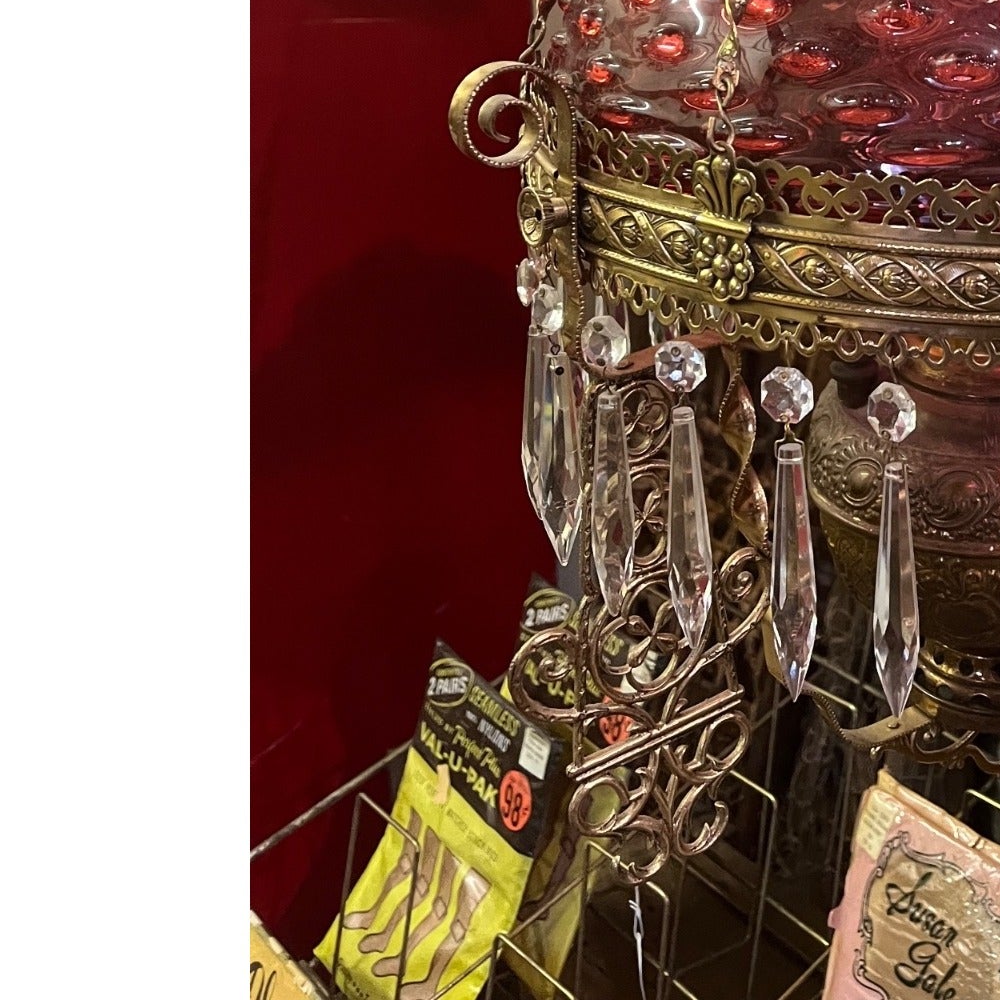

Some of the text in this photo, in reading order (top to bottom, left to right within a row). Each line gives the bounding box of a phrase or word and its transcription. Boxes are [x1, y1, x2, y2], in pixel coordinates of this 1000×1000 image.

[524, 607, 536, 627] 2
[535, 602, 569, 626] PAIRS
[427, 676, 468, 696] 2 PAIRS
[420, 721, 499, 809] VAL-U-PAK
[501, 784, 523, 827] 98
[886, 871, 958, 948] Susan
[894, 940, 959, 1000] Gale
